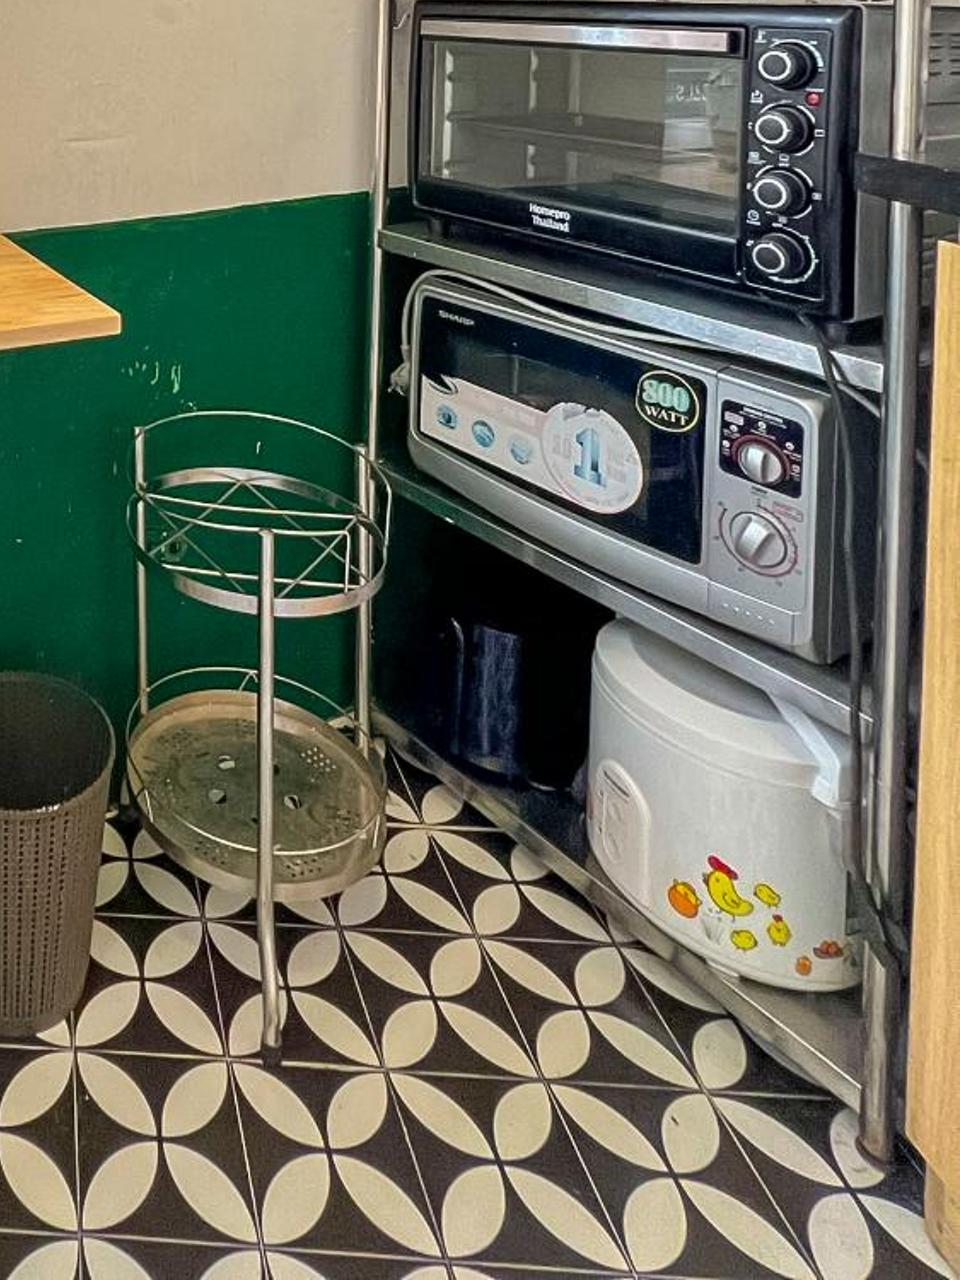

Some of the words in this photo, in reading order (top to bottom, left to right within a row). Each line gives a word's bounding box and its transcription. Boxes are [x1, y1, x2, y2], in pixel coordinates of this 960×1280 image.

[529, 202, 571, 221] Homepro
[531, 214, 570, 233] Thailand
[438, 310, 474, 325] SHARP
[642, 380, 690, 413] 800
[643, 405, 690, 425] WATT
[573, 427, 605, 487] 1
